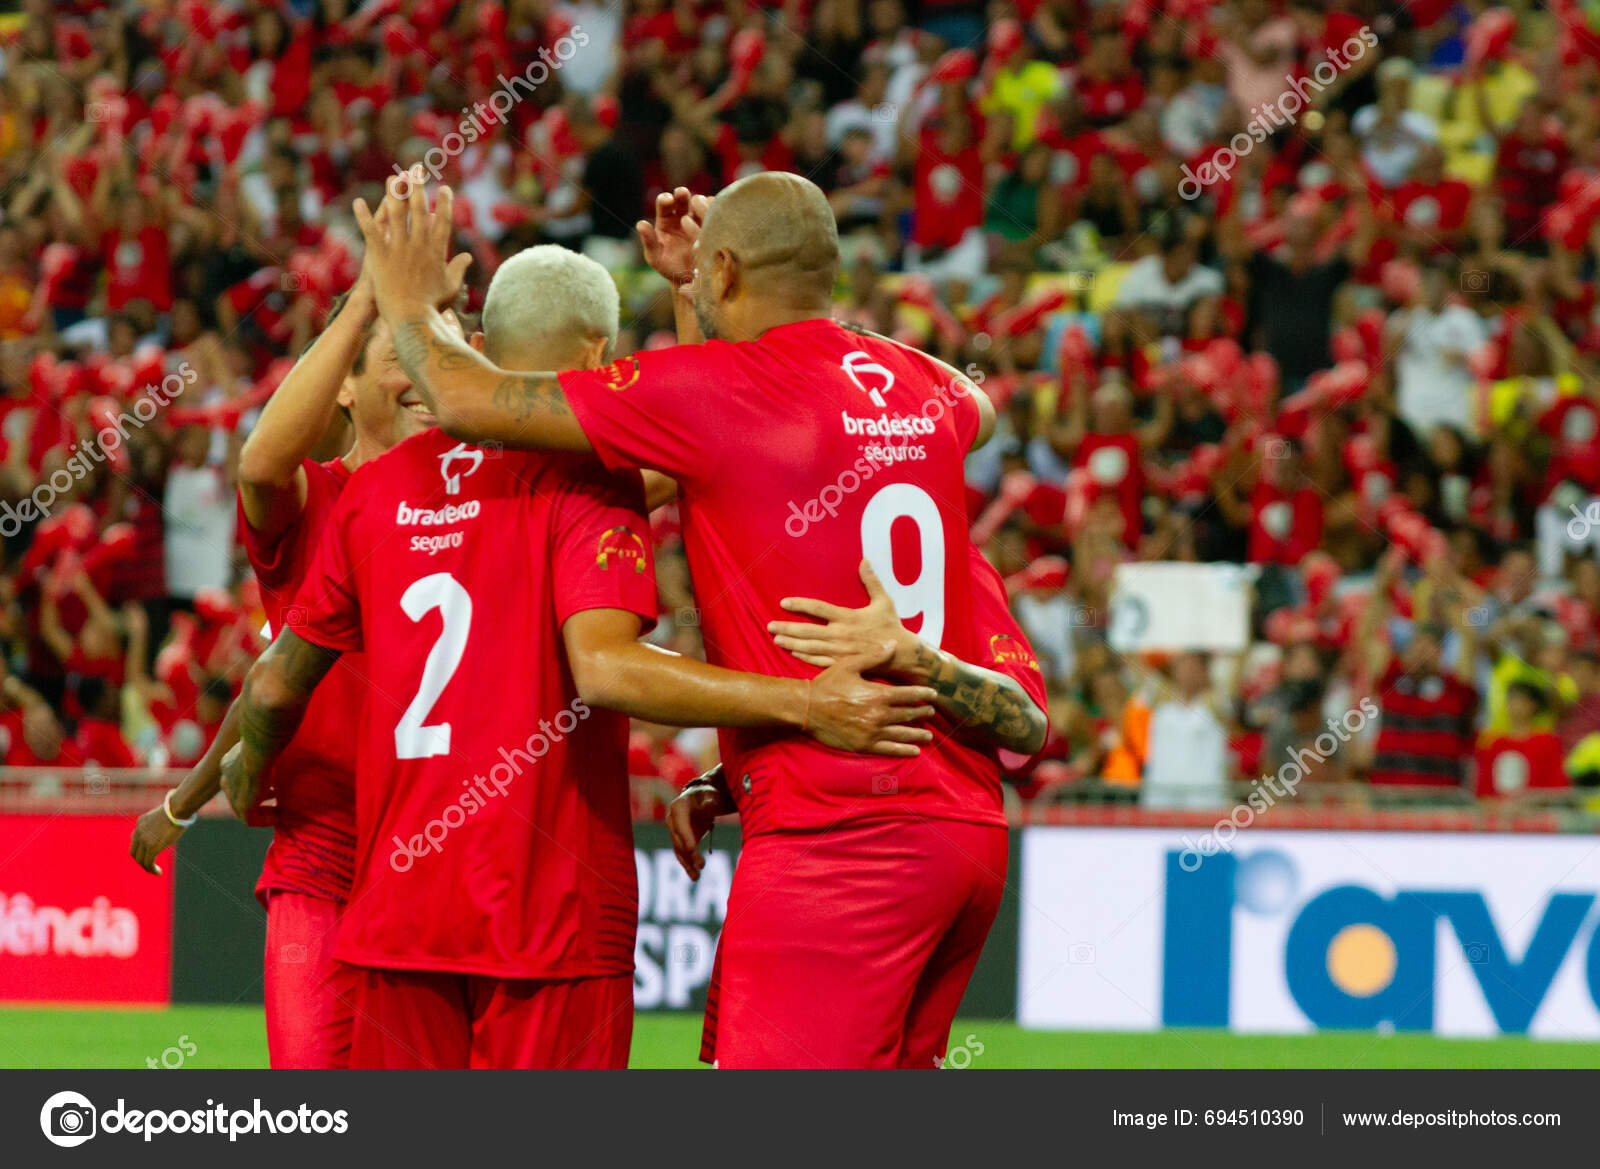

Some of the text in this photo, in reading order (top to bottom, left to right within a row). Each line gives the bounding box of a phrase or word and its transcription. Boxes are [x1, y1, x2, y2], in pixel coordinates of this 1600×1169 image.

[841, 410, 936, 436] bradesco
[864, 445, 927, 467] seguros
[396, 500, 480, 526] bradesco
[861, 482, 945, 650] 9
[394, 572, 472, 759] 2
[1162, 850, 1600, 1034] rav
